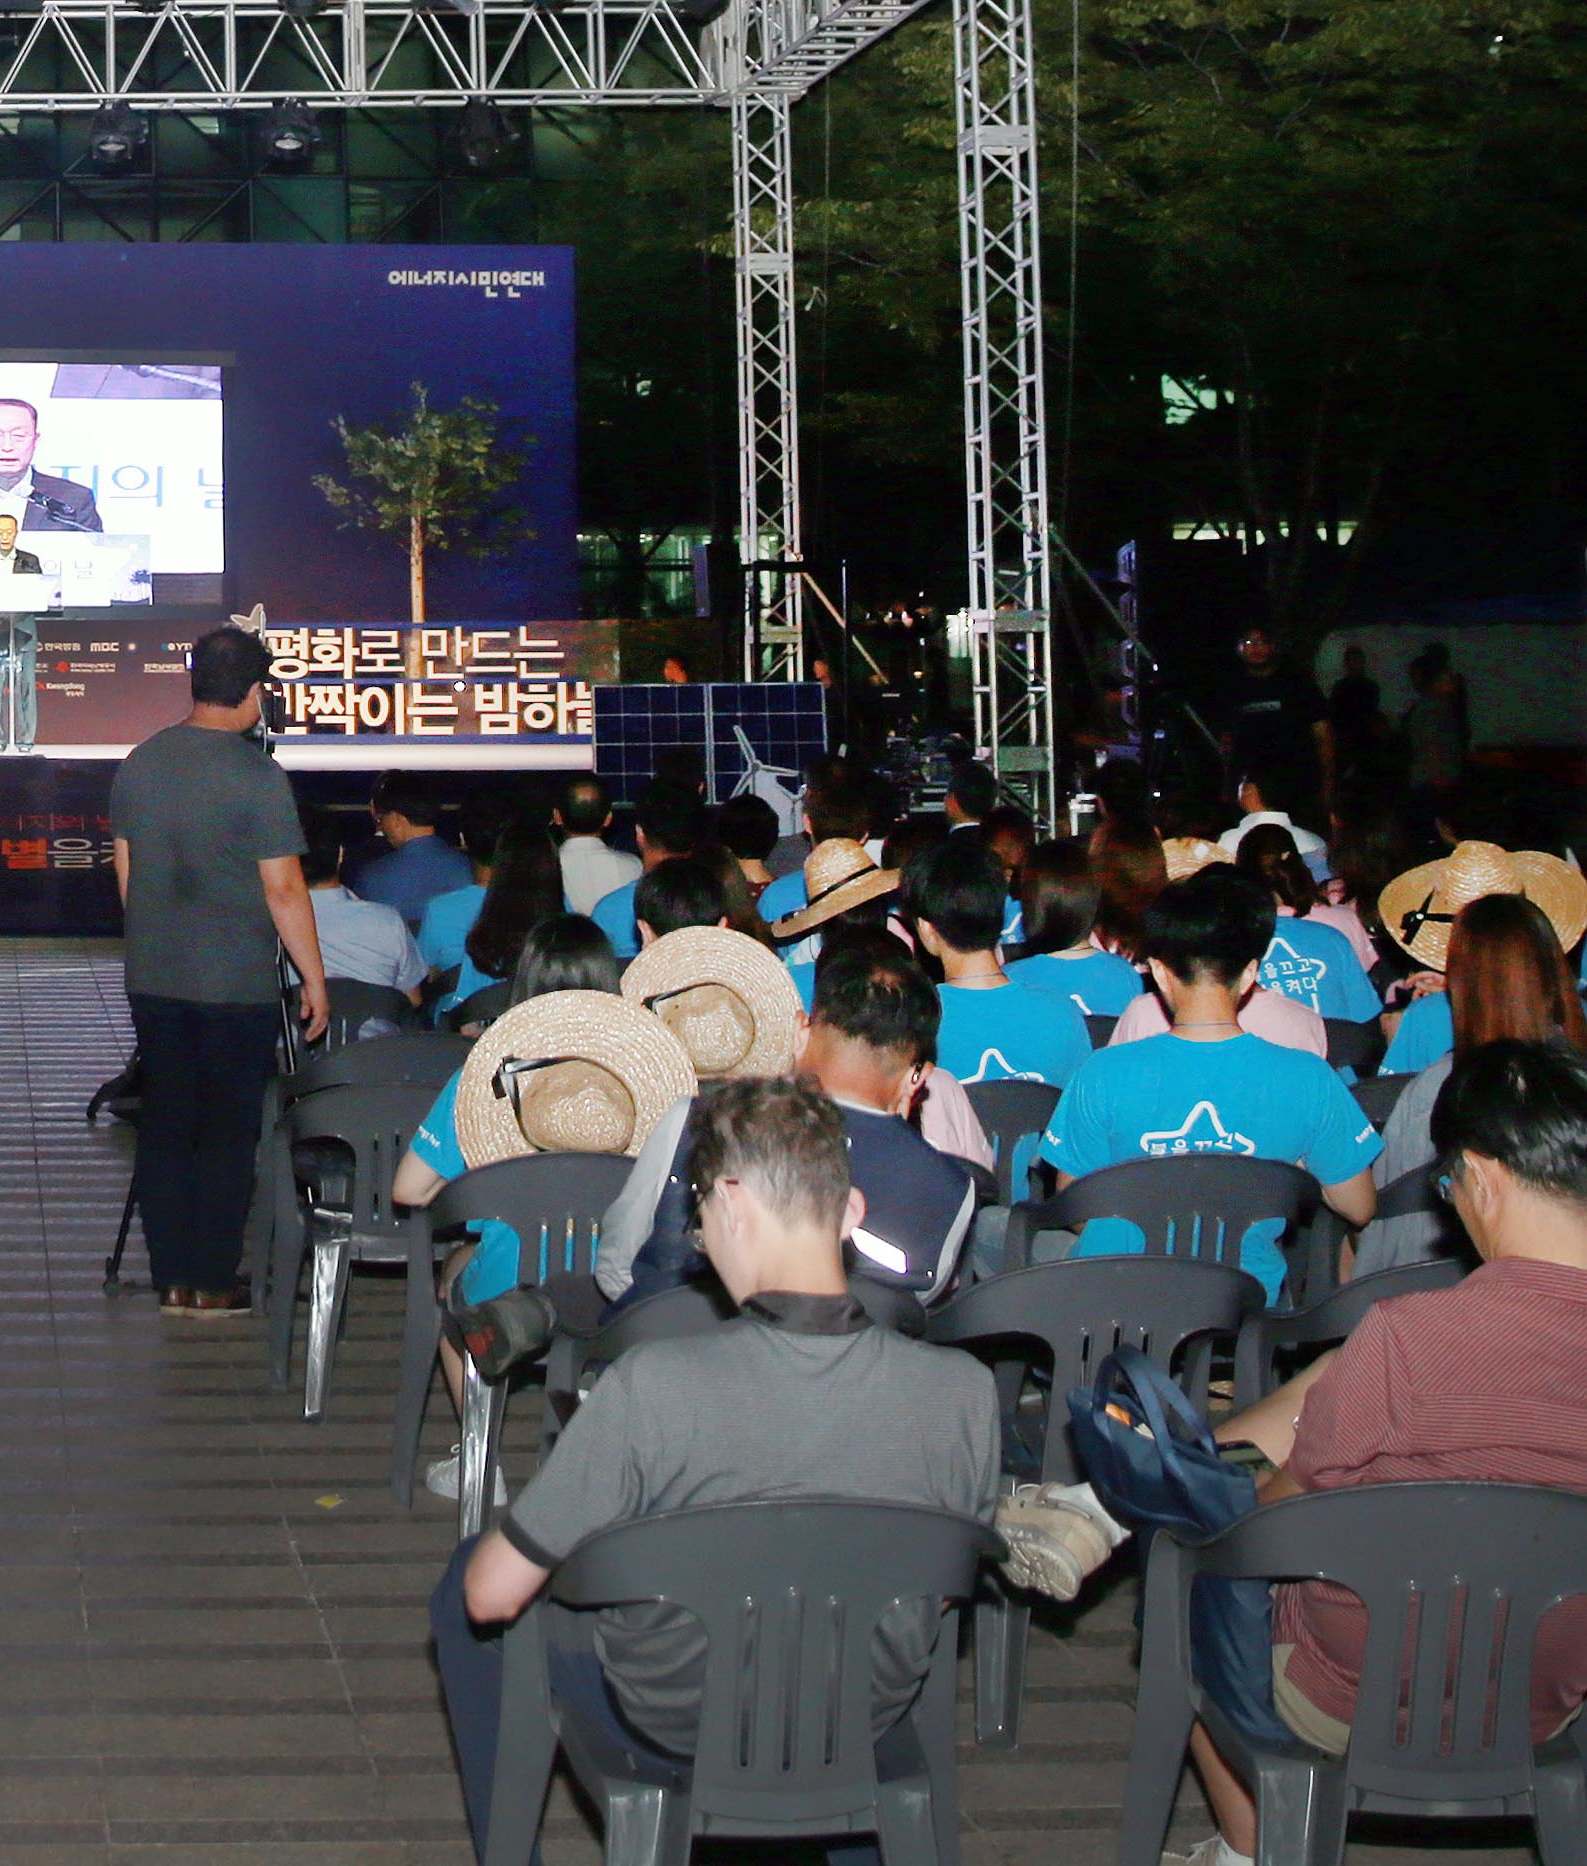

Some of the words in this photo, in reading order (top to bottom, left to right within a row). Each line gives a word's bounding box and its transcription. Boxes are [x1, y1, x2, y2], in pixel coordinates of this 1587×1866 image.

[387, 270, 545, 298] 에너지시민연대
[90, 641, 119, 652] MBC
[264, 626, 406, 680] 평화로
[420, 625, 565, 680] 만드는
[1256, 957, 1312, 982] 을끄고
